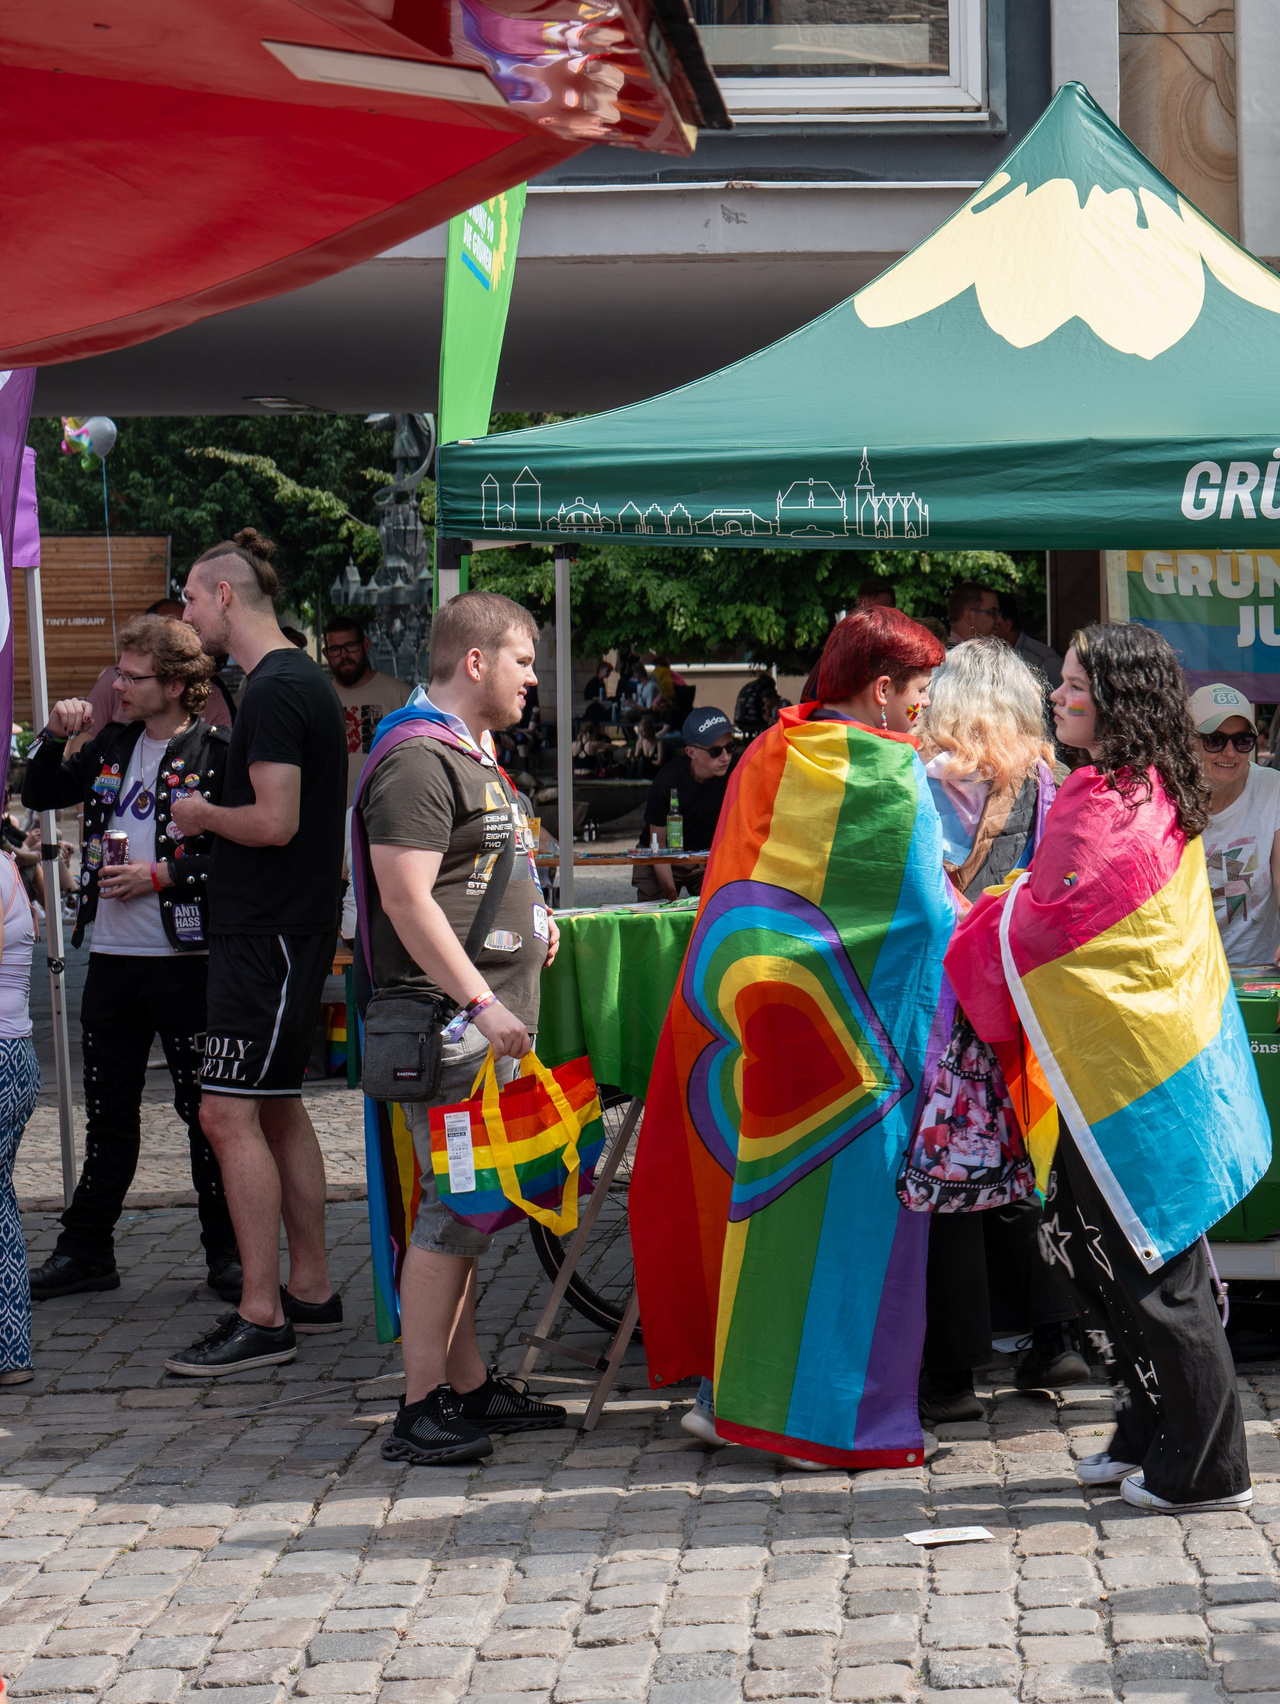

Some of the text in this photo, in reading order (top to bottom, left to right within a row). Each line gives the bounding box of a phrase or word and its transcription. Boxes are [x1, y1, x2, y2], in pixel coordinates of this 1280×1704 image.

[45, 616, 106, 626] TINY LIBRARY
[1217, 693, 1237, 704] 66
[698, 715, 727, 733] adidas
[485, 832, 510, 840] EIGHTY
[484, 841, 502, 849] TWO
[175, 905, 200, 917] ANTI
[175, 917, 201, 928] HASS
